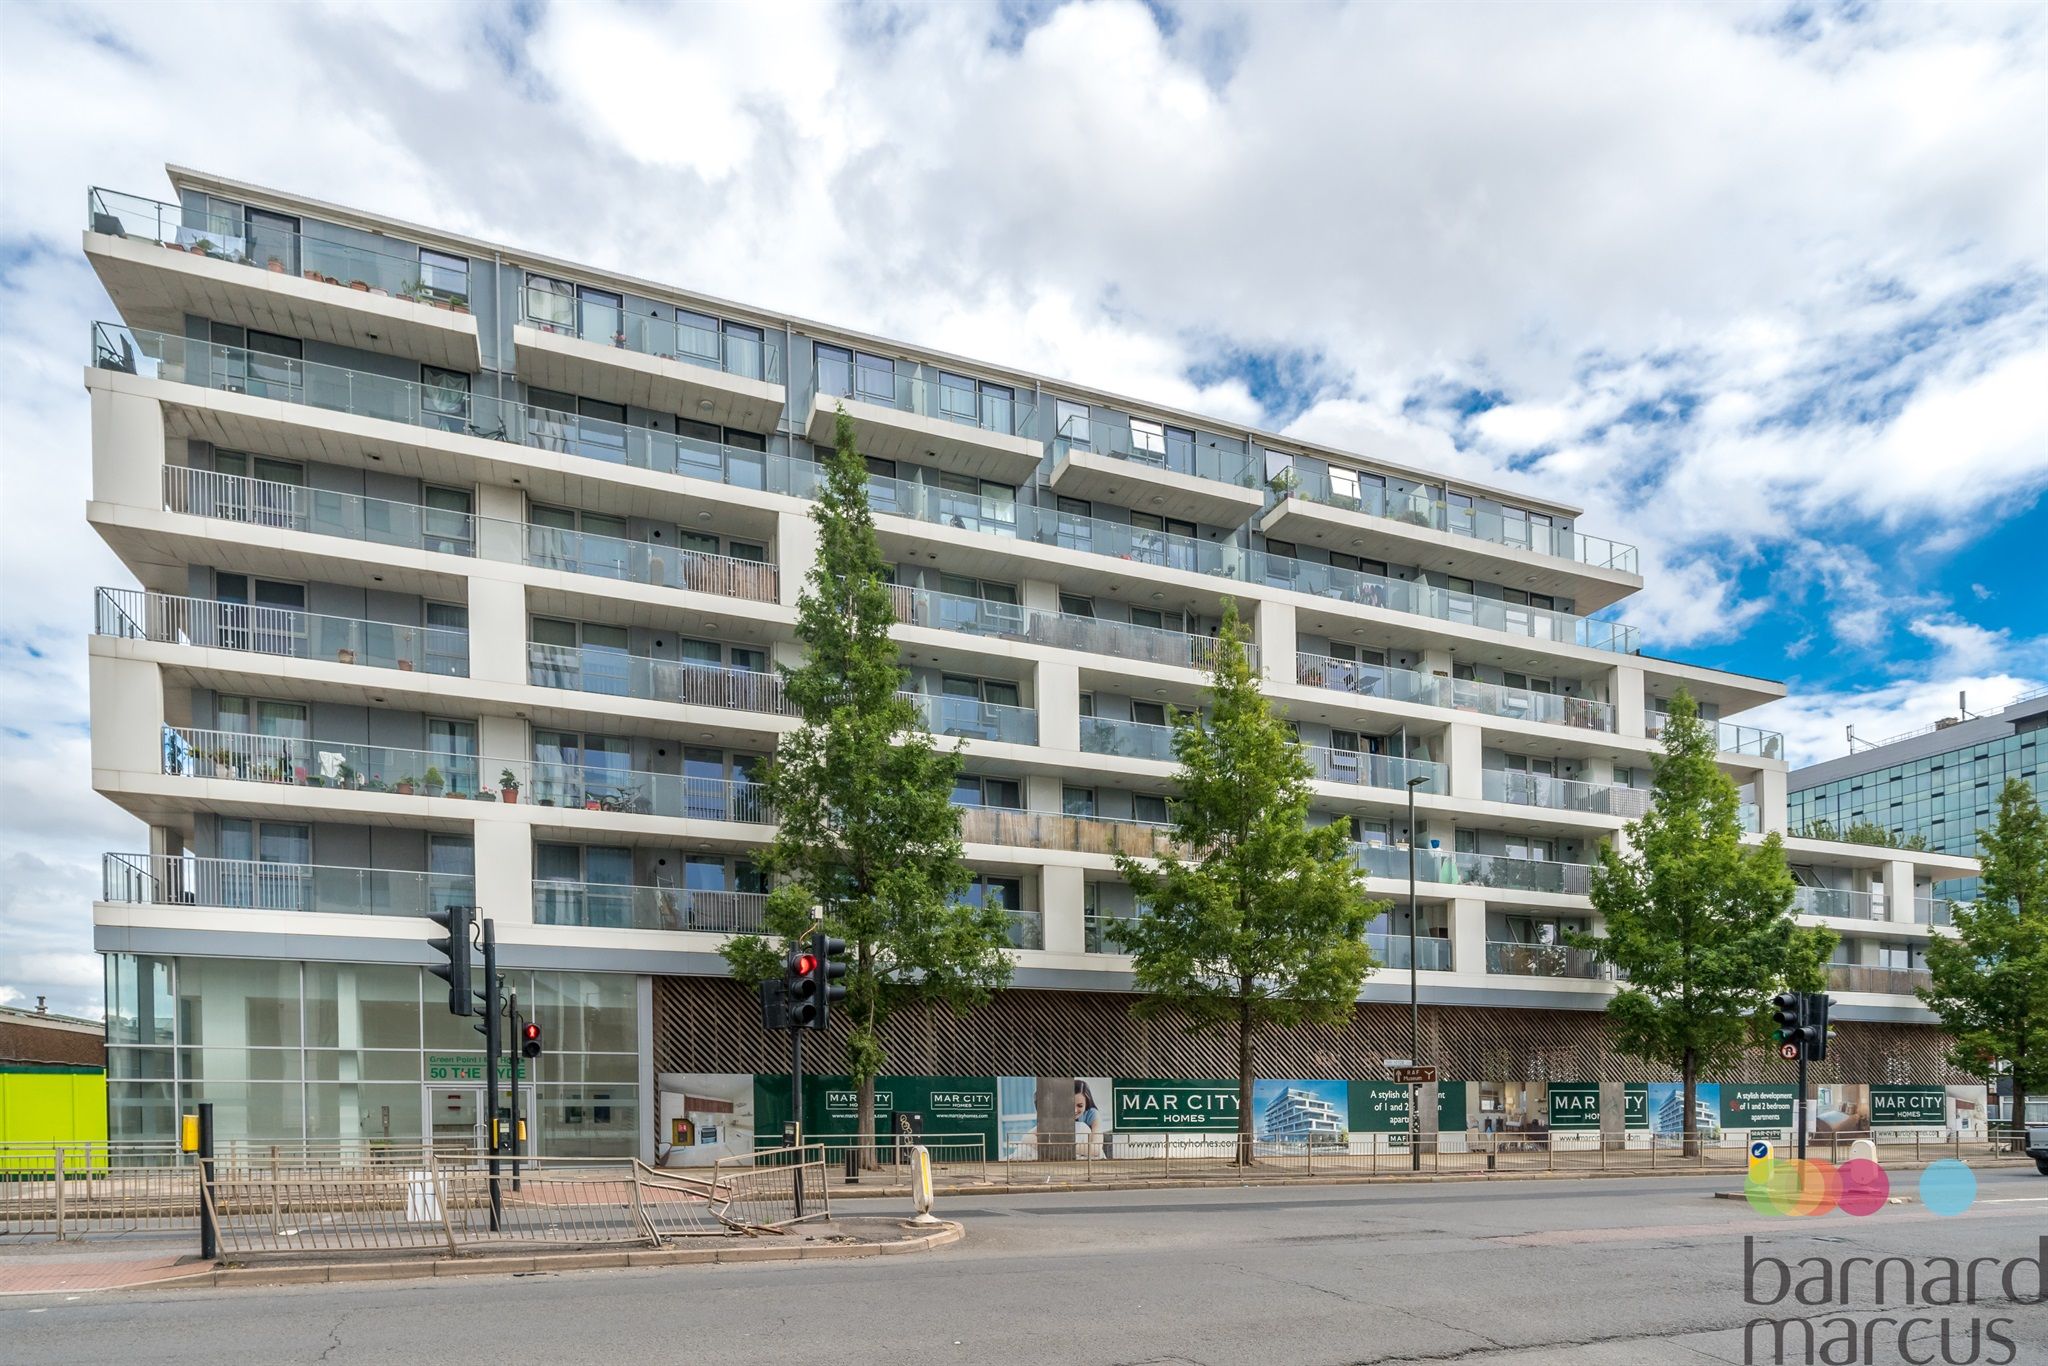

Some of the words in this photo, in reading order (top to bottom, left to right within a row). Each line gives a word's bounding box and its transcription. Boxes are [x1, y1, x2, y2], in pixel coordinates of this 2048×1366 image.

[430, 1067, 447, 1079] 50
[451, 1067, 481, 1079] THE
[495, 1068, 526, 1079] YDE
[829, 1094, 857, 1102] MAR
[934, 1094, 960, 1102] MAR
[963, 1095, 990, 1103] CITY
[1370, 1090, 1377, 1098] A
[1378, 1090, 1400, 1101] stylish
[1742, 1092, 1759, 1101] stylish
[1759, 1092, 1793, 1101] development
[1122, 1094, 1178, 1110] MAR
[1187, 1094, 1240, 1110] CITY
[1374, 1102, 1383, 1111] of
[1389, 1102, 1403, 1111] and
[1404, 1103, 1409, 1111] 2
[1555, 1096, 1596, 1109] MAR
[1874, 1096, 1906, 1108] MAR
[1909, 1096, 1942, 1108] CITY
[1163, 1114, 1206, 1123] HOMES
[1751, 1114, 1780, 1122] apartments
